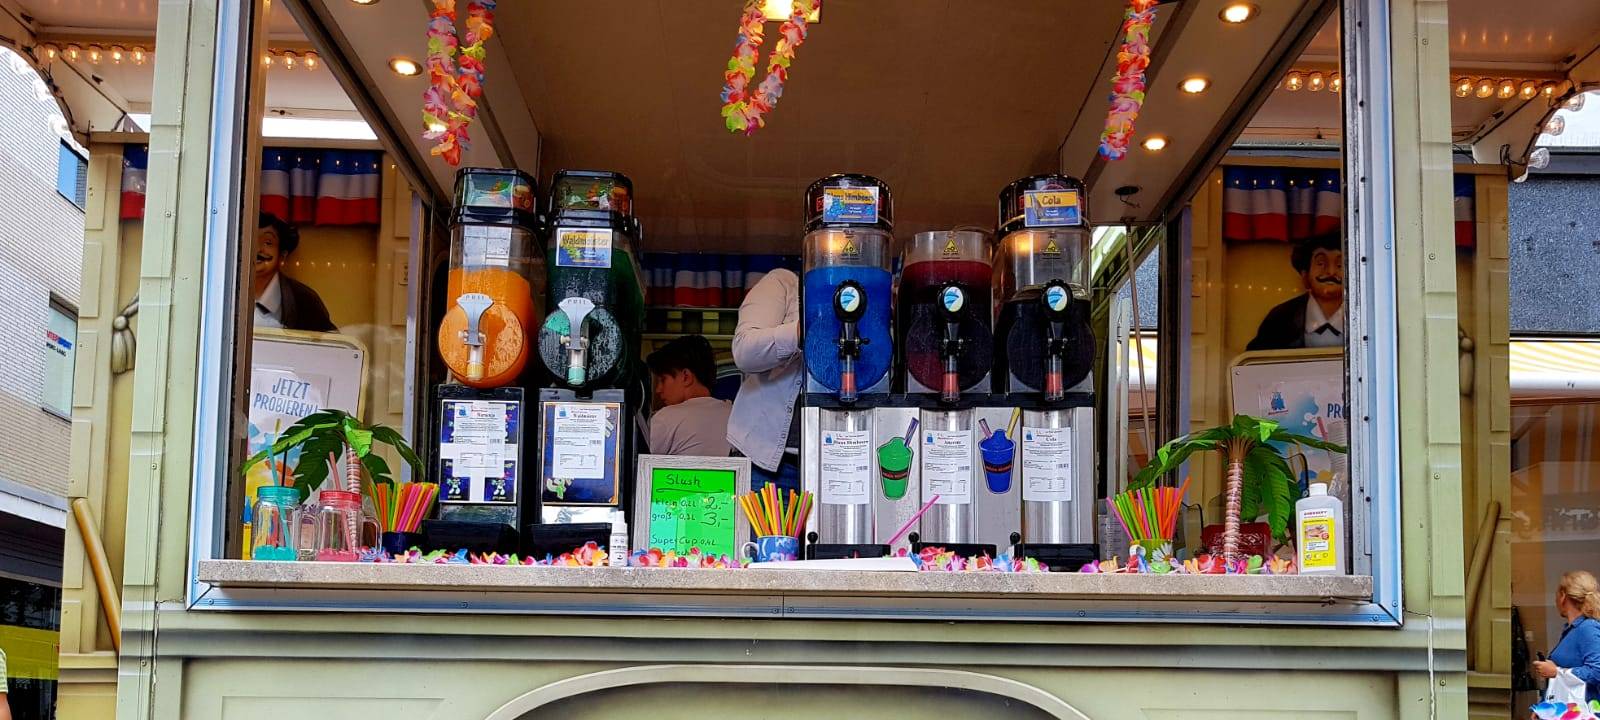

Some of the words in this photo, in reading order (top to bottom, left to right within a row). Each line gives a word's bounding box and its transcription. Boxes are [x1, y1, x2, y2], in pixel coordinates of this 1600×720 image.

[1042, 195, 1062, 205] Cola
[272, 377, 311, 400] JETZT
[678, 536, 698, 547] Cup
